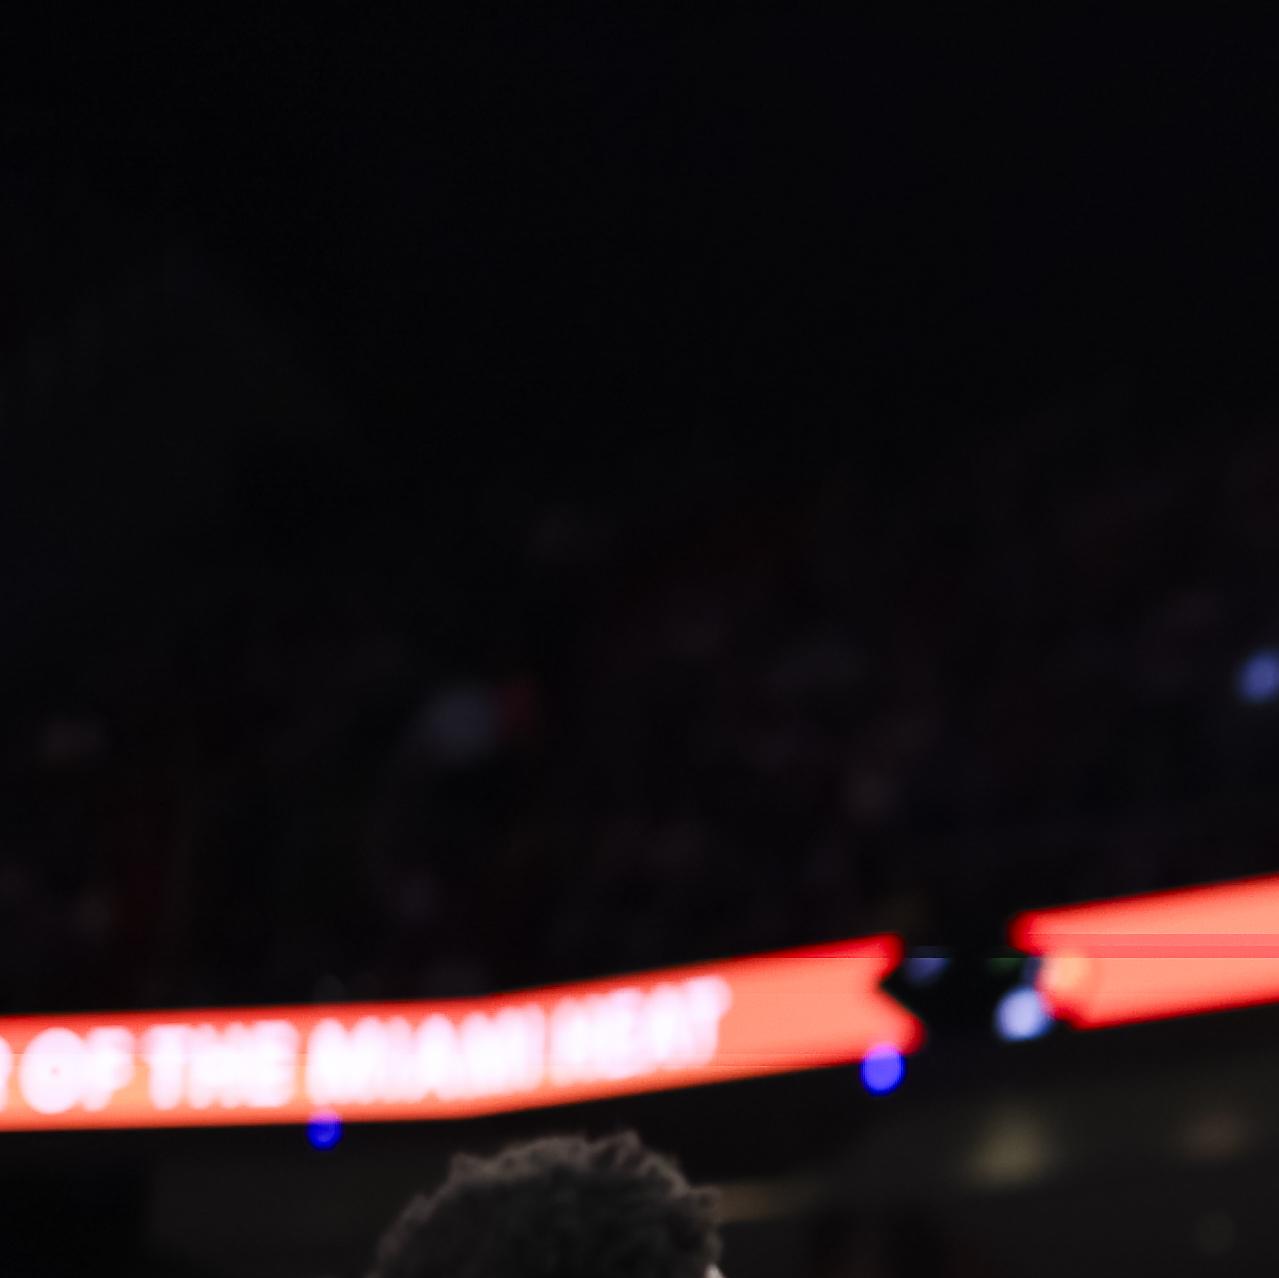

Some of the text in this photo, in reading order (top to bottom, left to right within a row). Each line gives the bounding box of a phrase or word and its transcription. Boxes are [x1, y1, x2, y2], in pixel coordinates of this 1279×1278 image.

[146, 1022, 299, 1110] THE
[306, 1008, 544, 1105] MIAMI
[550, 978, 731, 1085] HEAT
